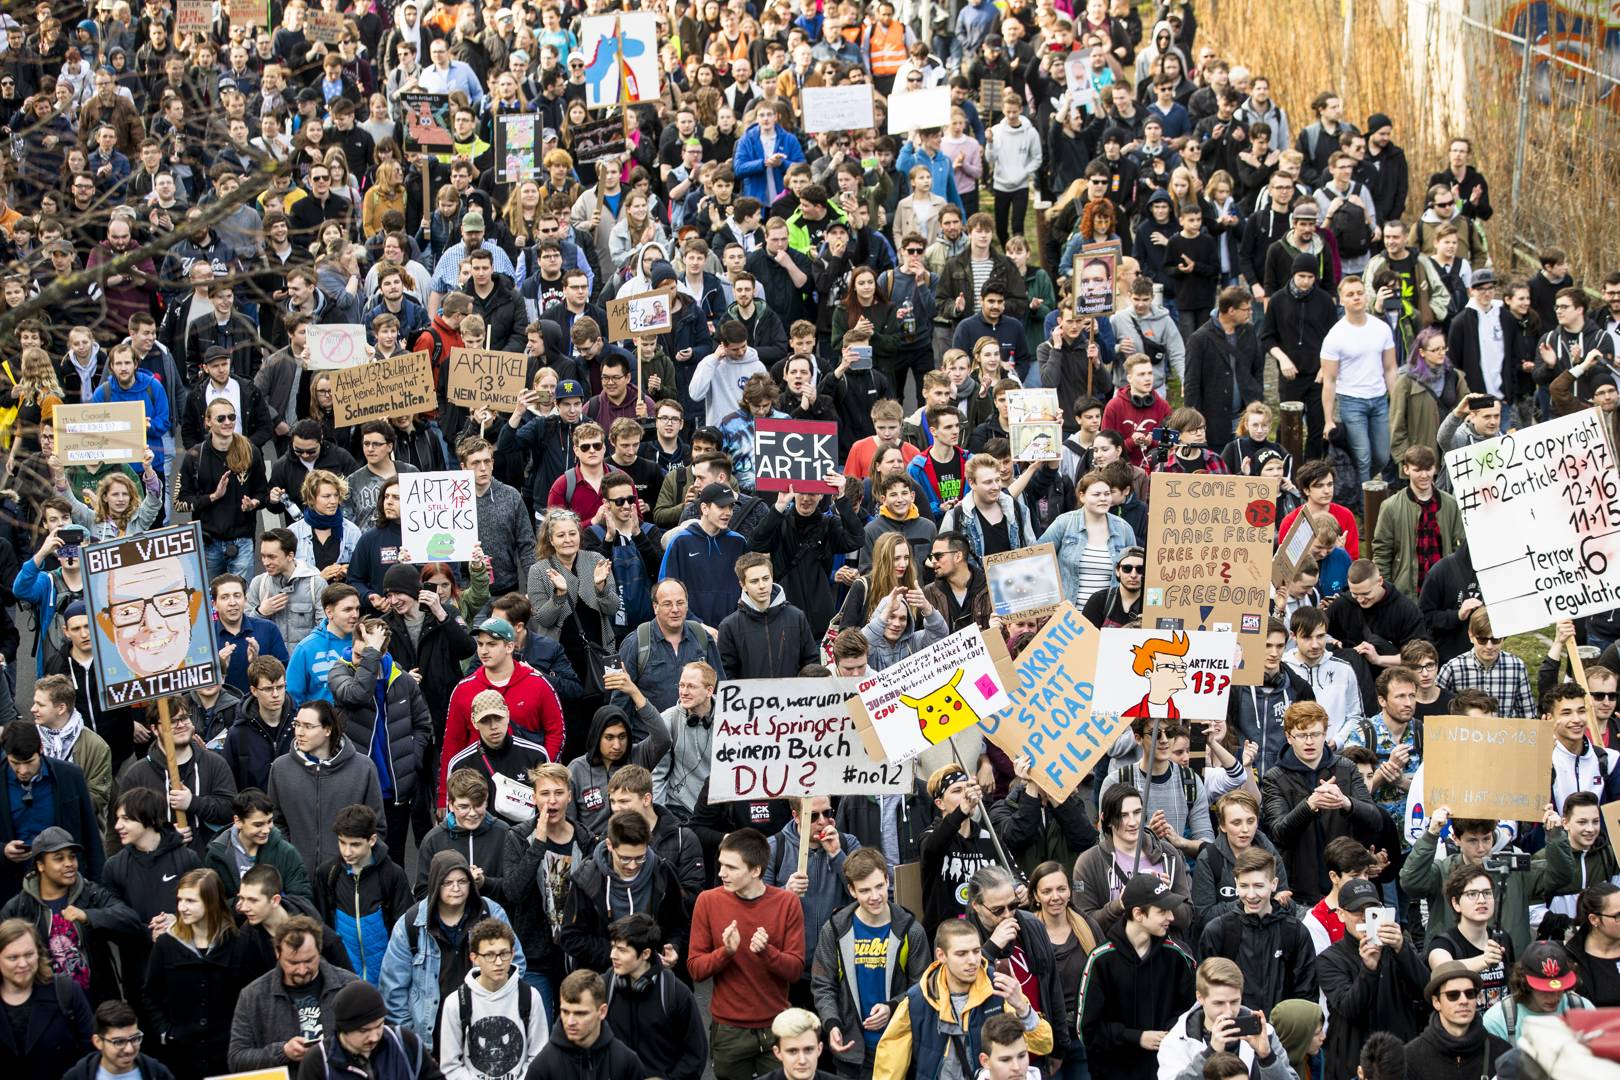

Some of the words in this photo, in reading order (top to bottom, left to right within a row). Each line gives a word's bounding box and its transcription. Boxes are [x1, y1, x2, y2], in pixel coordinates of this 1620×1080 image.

[612, 300, 639, 318] Artikel
[1076, 304, 1113, 313] Uploadfilter
[620, 309, 645, 331] 13?
[454, 353, 526, 378] ARTIKEL
[336, 368, 364, 392] Artikel
[365, 362, 382, 382] 13?
[475, 375, 506, 392] 13?
[335, 392, 352, 406] Wer
[354, 386, 376, 402] keine
[376, 380, 404, 397] Ahnung
[453, 387, 477, 401] NEIN
[80, 409, 111, 422] Google
[345, 399, 391, 421] Schnauze
[80, 434, 110, 450] Google
[756, 430, 833, 460] FCK
[756, 455, 836, 481] ART13
[941, 474, 956, 482] REAL
[407, 479, 449, 504] ART
[1166, 481, 1182, 498] I
[1188, 481, 1236, 499] COME
[1246, 483, 1270, 499] TO
[428, 504, 449, 512] STILL
[1164, 507, 1177, 525] A
[1183, 507, 1242, 525] WORLD
[407, 509, 475, 532] SUCKS
[136, 530, 196, 563] VOSS
[1163, 527, 1215, 546] MADE
[1223, 527, 1273, 545] FREE.
[381, 549, 397, 557] FCK
[986, 552, 1022, 566] ARTIKEL
[1158, 547, 1194, 565] FREE
[1201, 546, 1249, 564] FROM
[1526, 544, 1576, 573] terror
[1581, 535, 1609, 577] 6
[1160, 562, 1232, 584] WHAT?
[1535, 561, 1592, 594] content
[1165, 585, 1266, 610] FREEDOM
[1001, 611, 1027, 622] NEIN
[1242, 616, 1260, 625] FCK
[859, 677, 878, 692] CDU:
[878, 674, 890, 684] Wir
[892, 661, 914, 679] wollen
[914, 651, 931, 667] junge
[902, 666, 920, 680] alles
[933, 647, 961, 665] Artikel
[1188, 658, 1230, 670] ARTIKEL
[901, 671, 935, 693] Verbreitet
[1191, 670, 1231, 696] 13?
[721, 684, 786, 722] Papa,
[786, 691, 843, 711] warum
[1018, 664, 1075, 729] STATT
[874, 702, 899, 721] CDU:
[717, 715, 760, 737] Axel
[765, 714, 853, 743] Springer
[1428, 725, 1507, 745] WNDOWS
[716, 741, 781, 763] deinem
[787, 733, 852, 758] Buch
[843, 763, 904, 786] #no12
[584, 789, 601, 803] FCK
[750, 805, 769, 814] FCK
